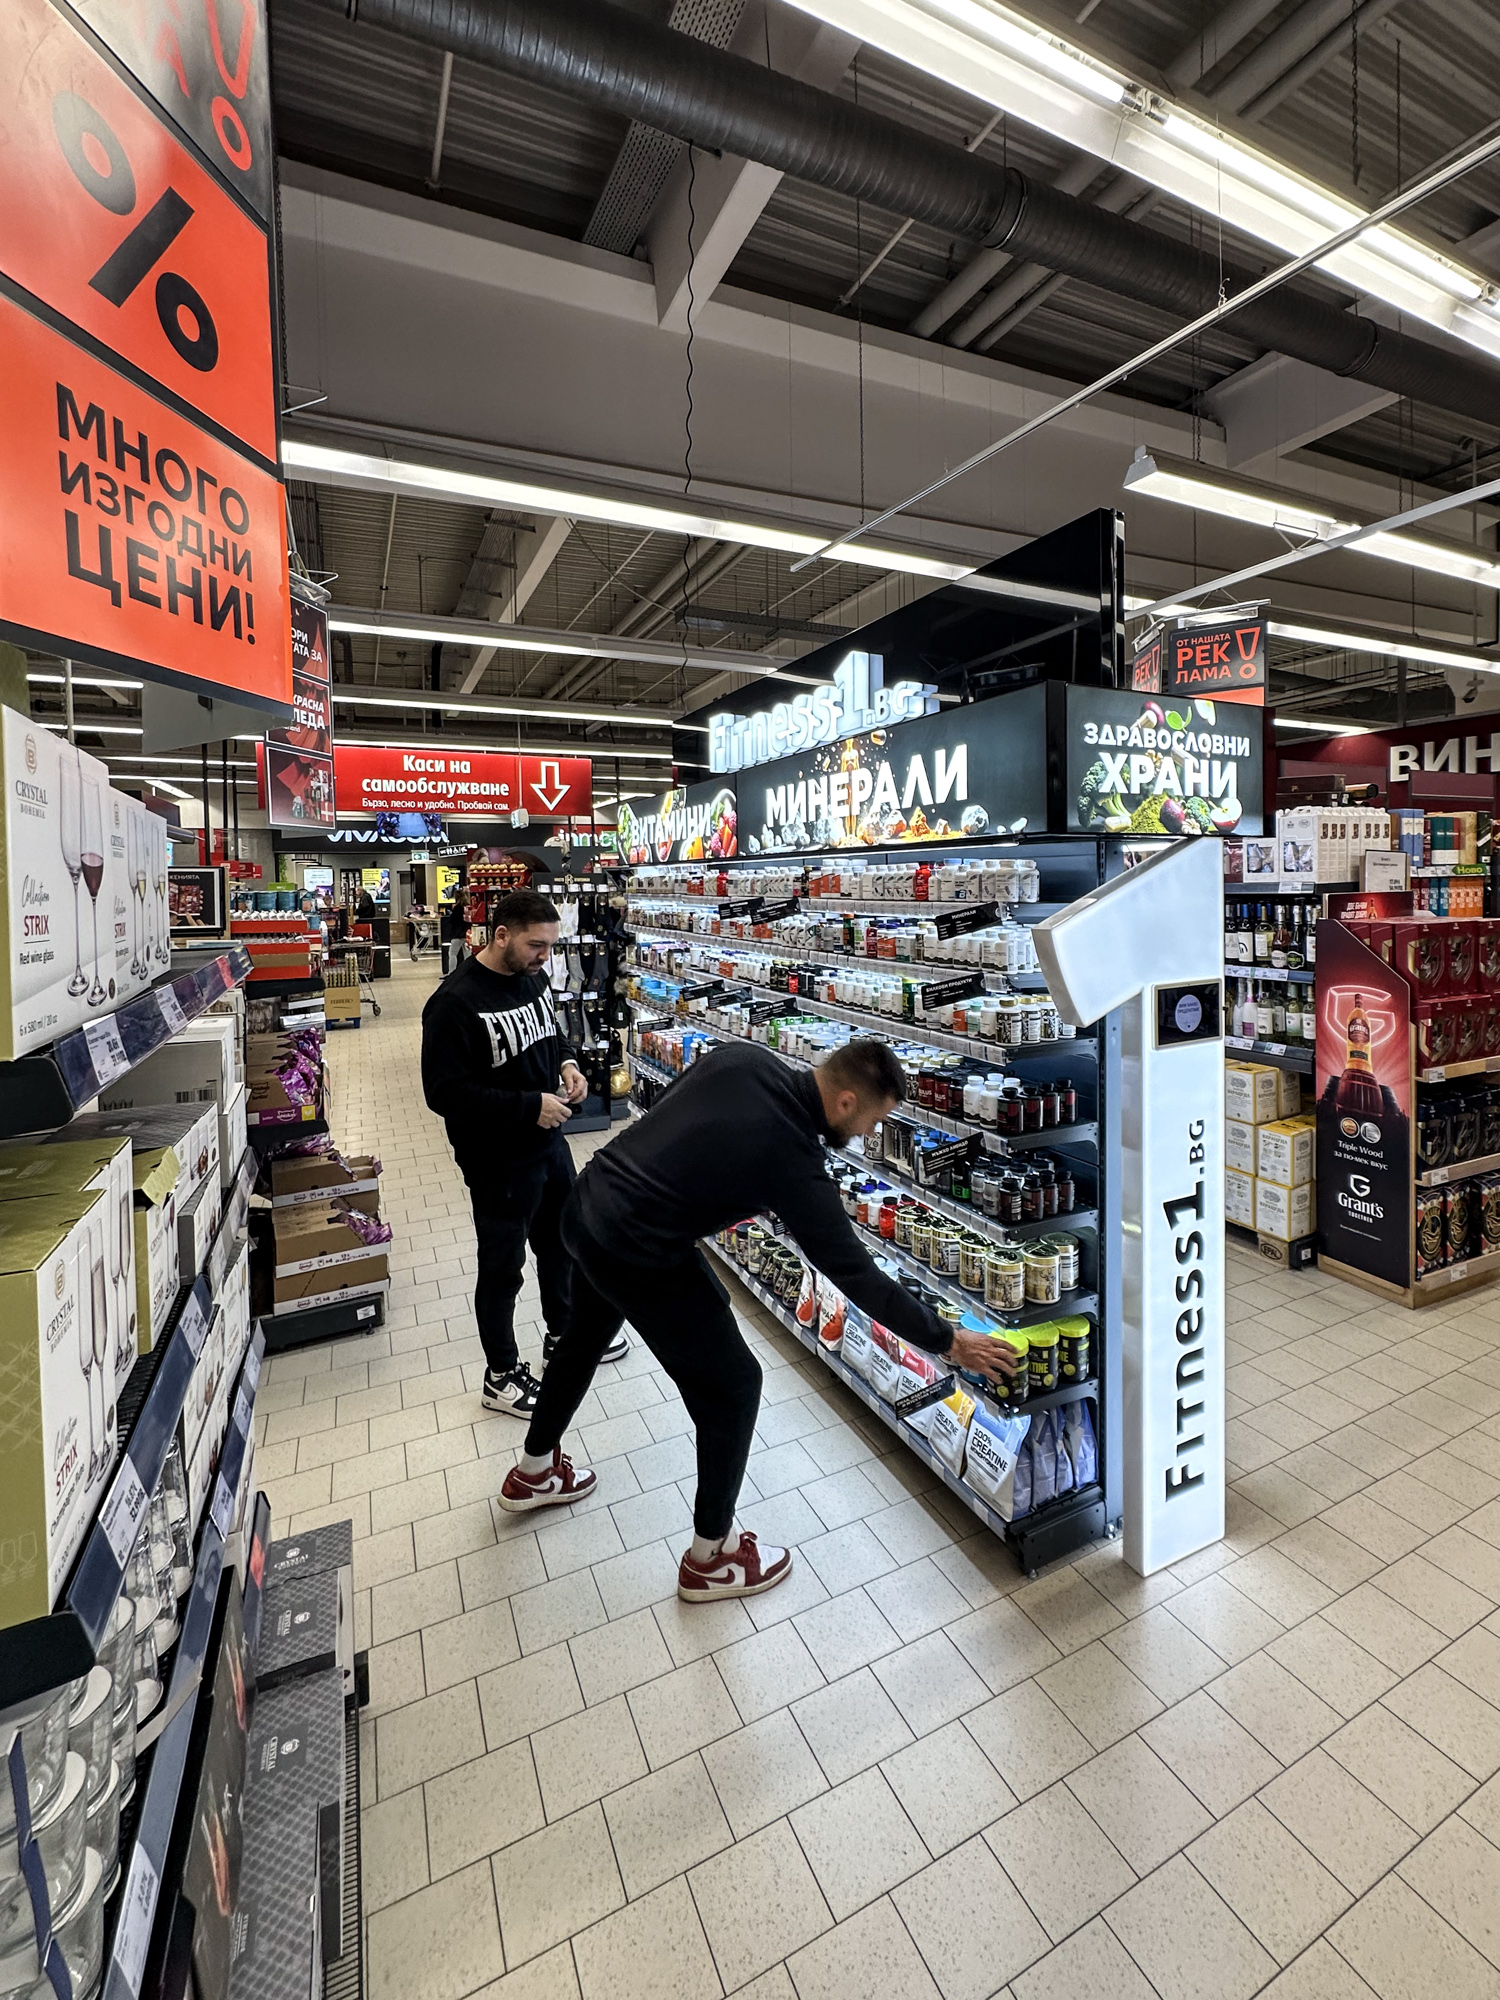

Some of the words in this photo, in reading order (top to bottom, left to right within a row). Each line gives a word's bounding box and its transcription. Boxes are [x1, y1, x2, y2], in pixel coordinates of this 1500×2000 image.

[56, 382, 250, 535] МНОГО
[59, 450, 254, 583] ИЗГОДНИ
[65, 509, 256, 646] ЦЕНИ!
[1176, 638, 1189, 648] ОТ
[1191, 633, 1232, 646] НАШАТА
[311, 649, 323, 664] ЗА
[1177, 641, 1232, 669] РЕК
[1175, 664, 1233, 684] ЛАМА
[1083, 722, 1251, 757] ЗДРАВОСЛОВНИ
[403, 754, 446, 773] Каси
[450, 760, 471, 774] на
[1390, 732, 1500, 783] ВИН
[362, 777, 510, 798] самообслужване
[766, 743, 968, 828] МИНЕРАЛИ
[1098, 752, 1239, 800] ХРАНИ
[16, 780, 48, 805] CRYSTAL
[390, 800, 416, 809] лесно
[417, 801, 424, 809] и
[457, 800, 492, 811] Пробвай
[631, 803, 712, 847] ВИТАМИНИ
[21, 874, 50, 909] Collection
[24, 914, 50, 937] STRIX
[20, 952, 30, 966] Red
[31, 951, 42, 963] wine
[43, 950, 55, 965] glass
[1334, 1149, 1344, 1158] за
[1346, 1152, 1370, 1166] по-мек
[1371, 1159, 1389, 1171] вкус
[1337, 1139, 1358, 1154] Triple
[1359, 1145, 1384, 1159] Wood
[1338, 1191, 1384, 1220] Grant's
[46, 1294, 75, 1342] CRYSTAL
[845, 1327, 868, 1348] CREATINE
[871, 1350, 893, 1373] CREATINE
[935, 1408, 959, 1437] CREATINE
[973, 1427, 993, 1447] 100%
[56, 1439, 78, 1497] STRIX
[971, 1436, 1009, 1473] CREATINE
[269, 1736, 279, 1770] CRYSTAL
